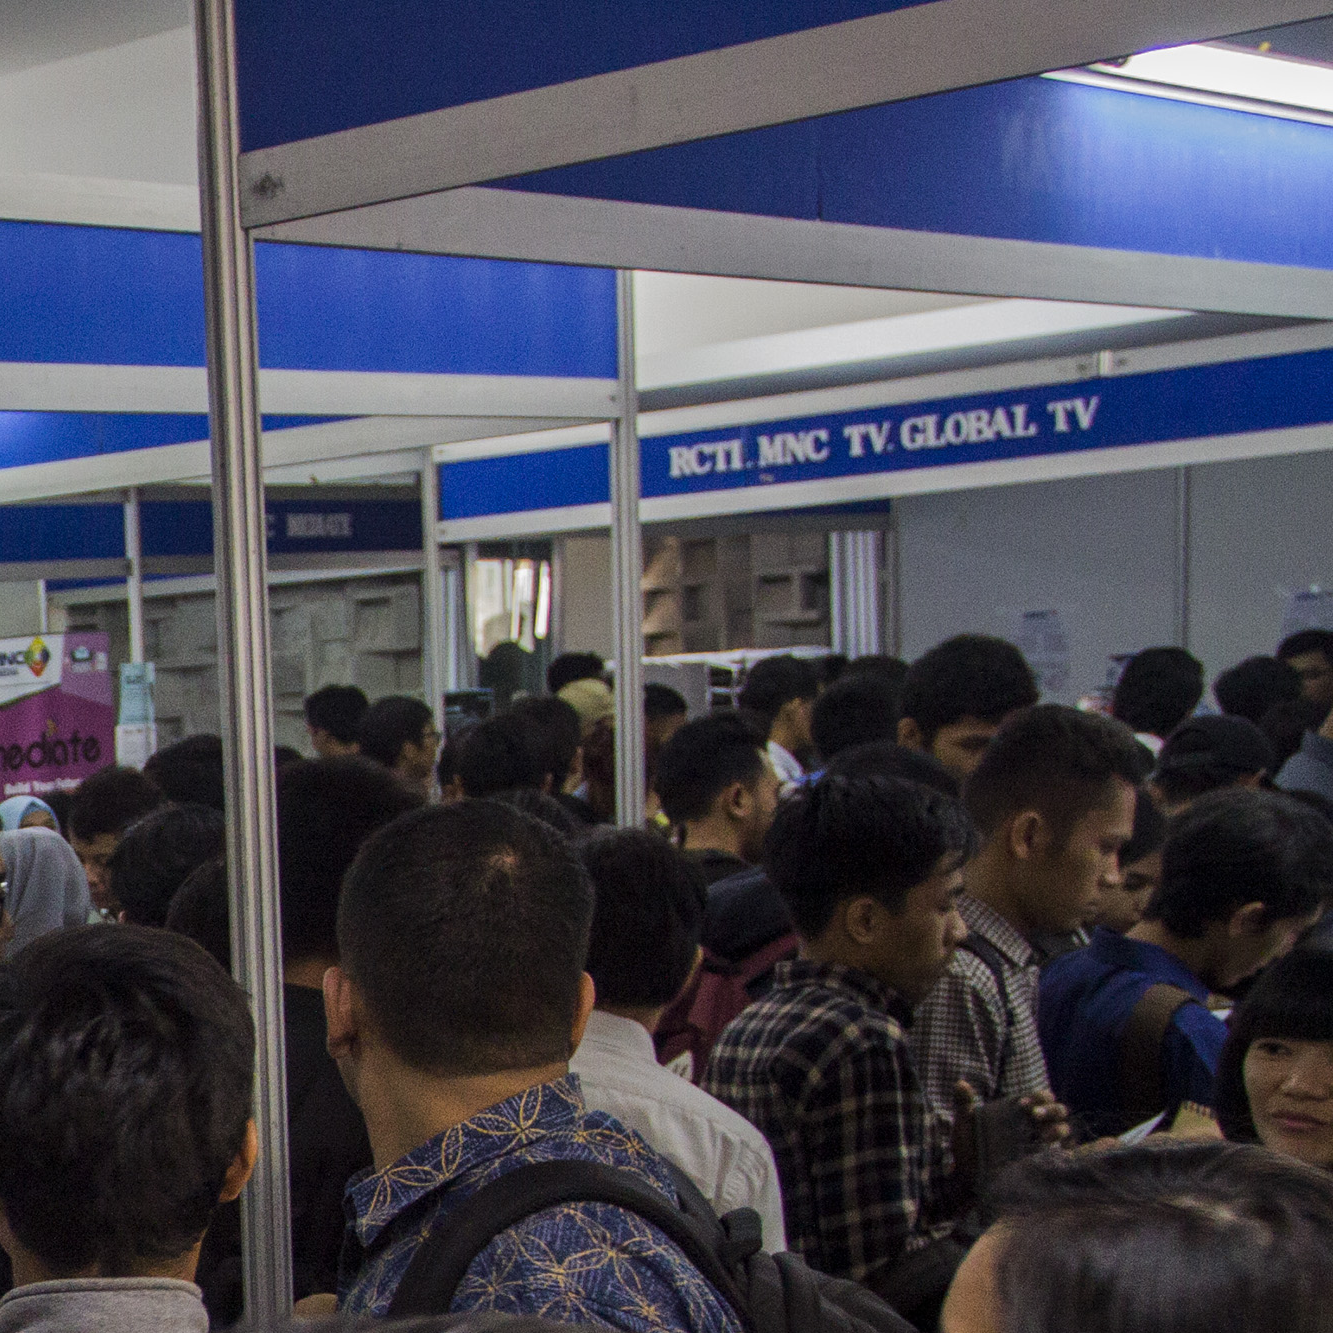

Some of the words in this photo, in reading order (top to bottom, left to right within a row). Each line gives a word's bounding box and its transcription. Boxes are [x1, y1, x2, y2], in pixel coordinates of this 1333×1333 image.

[757, 429, 830, 467] MNC
[899, 404, 1038, 451] GLOBAL
[1046, 396, 1100, 433] TV
